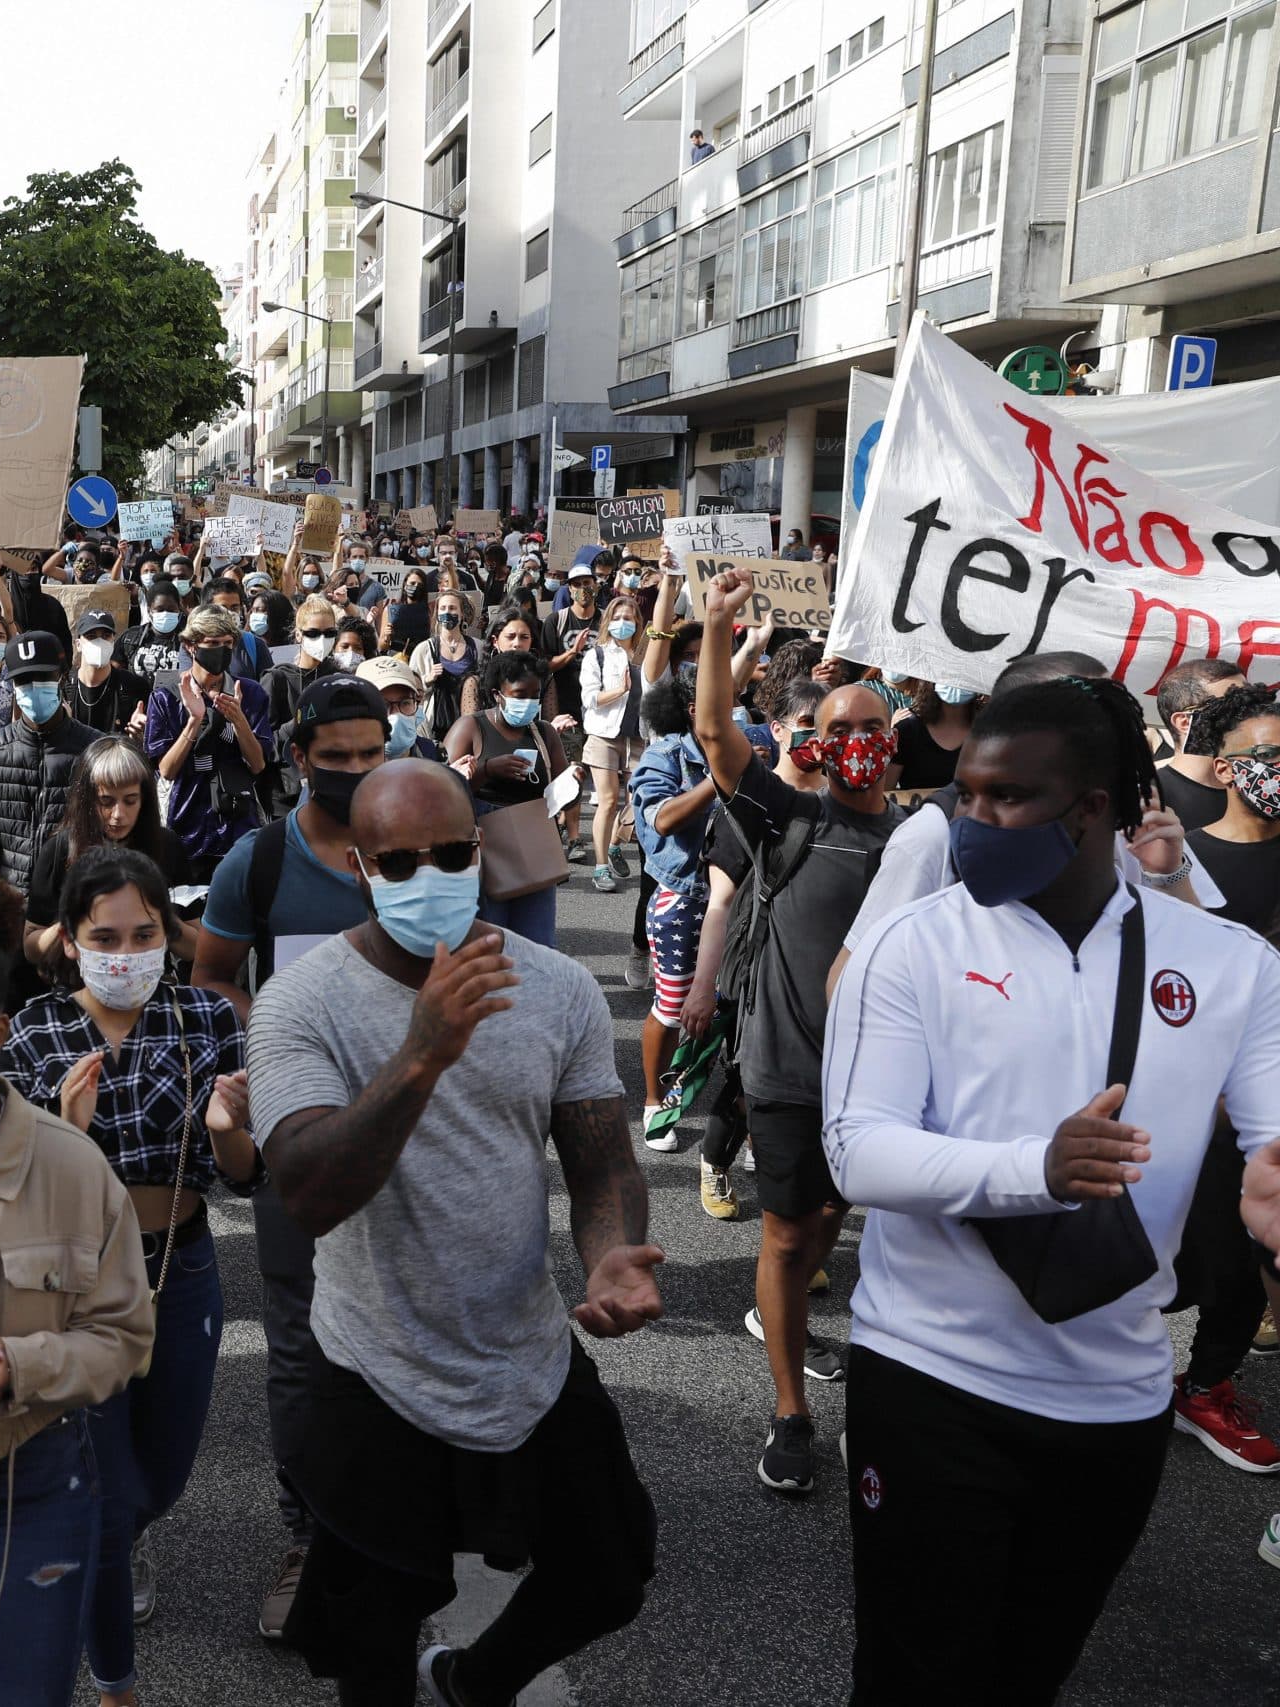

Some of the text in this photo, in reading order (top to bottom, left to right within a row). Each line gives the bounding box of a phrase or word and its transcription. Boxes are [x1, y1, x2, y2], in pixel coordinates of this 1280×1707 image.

[1003, 402, 1204, 577] Não
[120, 502, 145, 515] STOP
[600, 495, 665, 518] CAPITALISMO
[612, 514, 660, 537] MATA!
[675, 521, 720, 537] BLACK
[692, 534, 744, 551] LIVES
[372, 572, 400, 586] TONI
[891, 497, 1096, 662] ter
[17, 641, 35, 660] U
